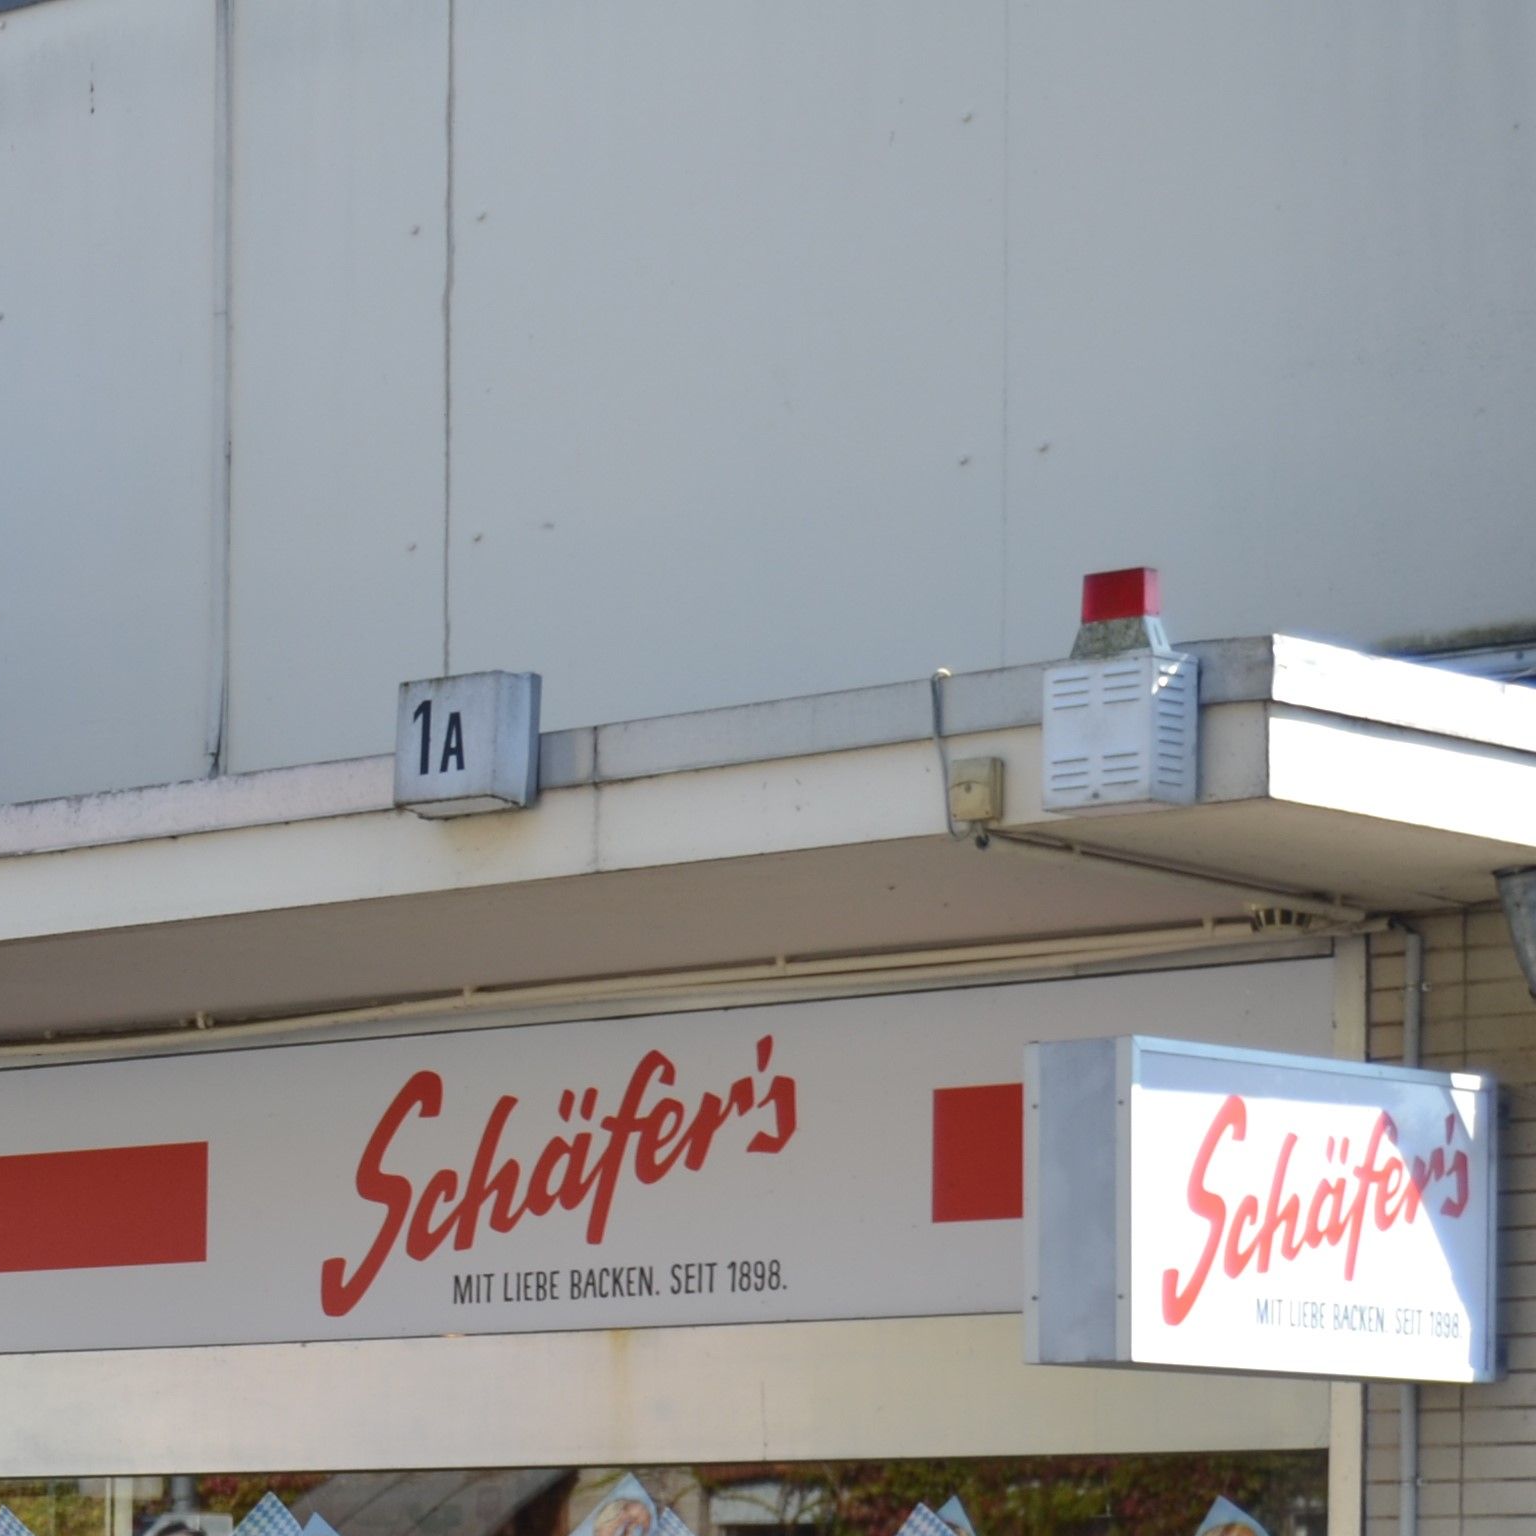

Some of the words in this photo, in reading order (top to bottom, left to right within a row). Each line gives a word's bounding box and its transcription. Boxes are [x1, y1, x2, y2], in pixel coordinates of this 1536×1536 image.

[412, 699, 466, 776] 1A
[319, 1034, 797, 1317] Schäfer's
[1161, 1094, 1470, 1327] Schäfer's
[453, 1273, 495, 1305] MIT
[503, 1270, 560, 1302] LIEBE
[569, 1265, 660, 1300] BACKEN.
[670, 1262, 718, 1295] SEIT
[727, 1259, 788, 1293] 1898.
[1256, 1297, 1283, 1326] MIT
[1289, 1299, 1326, 1331] LIEBE
[1333, 1302, 1389, 1334] BACKEN.
[1395, 1308, 1425, 1336] SEIT
